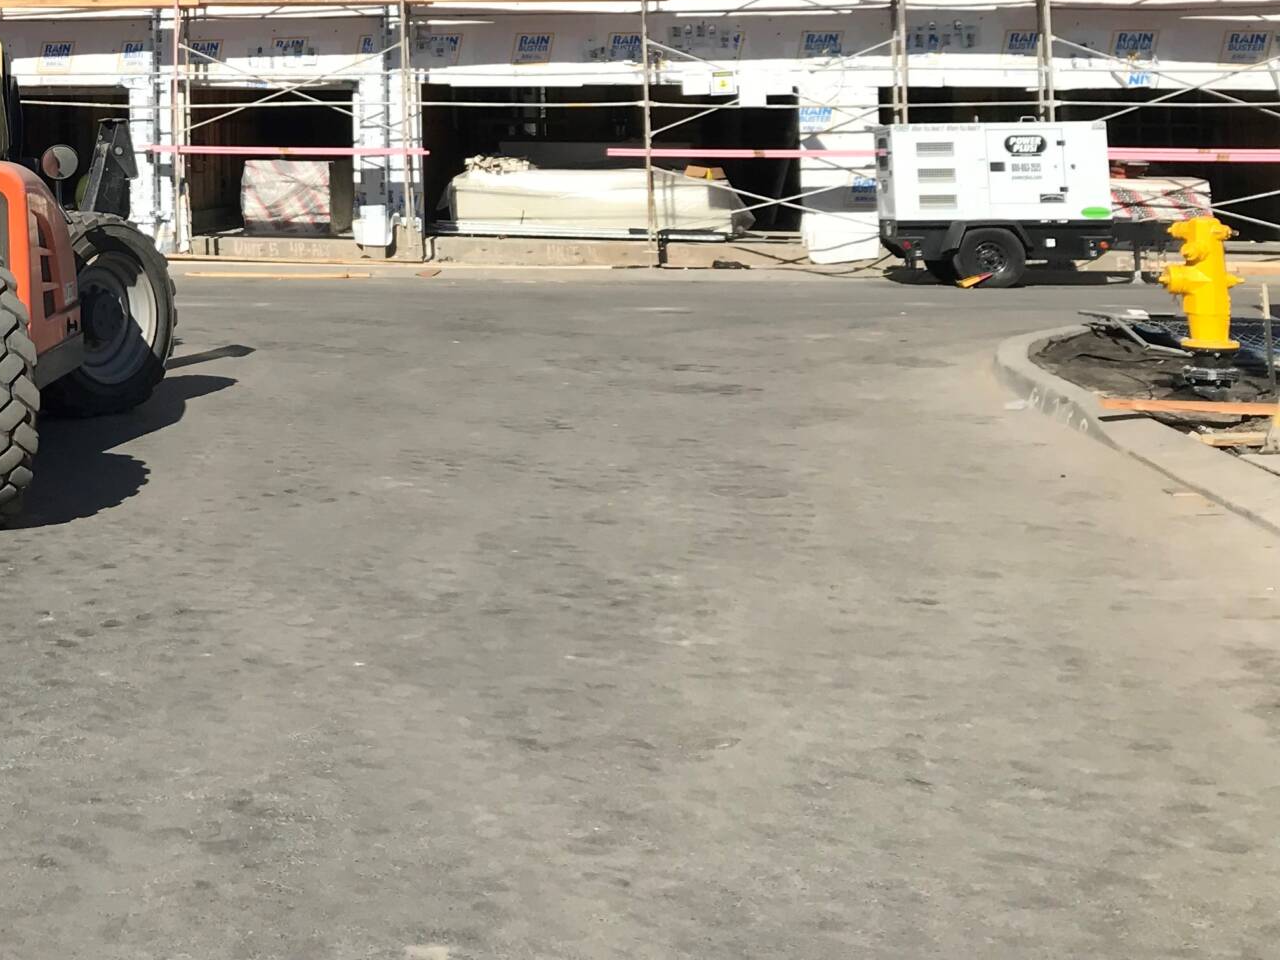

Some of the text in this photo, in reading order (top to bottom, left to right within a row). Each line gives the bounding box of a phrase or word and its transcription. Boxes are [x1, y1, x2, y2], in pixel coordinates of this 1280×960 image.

[519, 35, 549, 46] RAIN
[612, 35, 642, 45] RAIN
[805, 33, 839, 44] RAIN
[1010, 32, 1039, 43] RAI
[1117, 32, 1154, 43] RAIN
[1231, 32, 1266, 43] RAIN
[45, 43, 71, 53] RAIN
[124, 42, 143, 52] RAI
[192, 42, 219, 52] RAIN
[801, 107, 832, 117] RAIN
[1009, 136, 1042, 146] POWER
